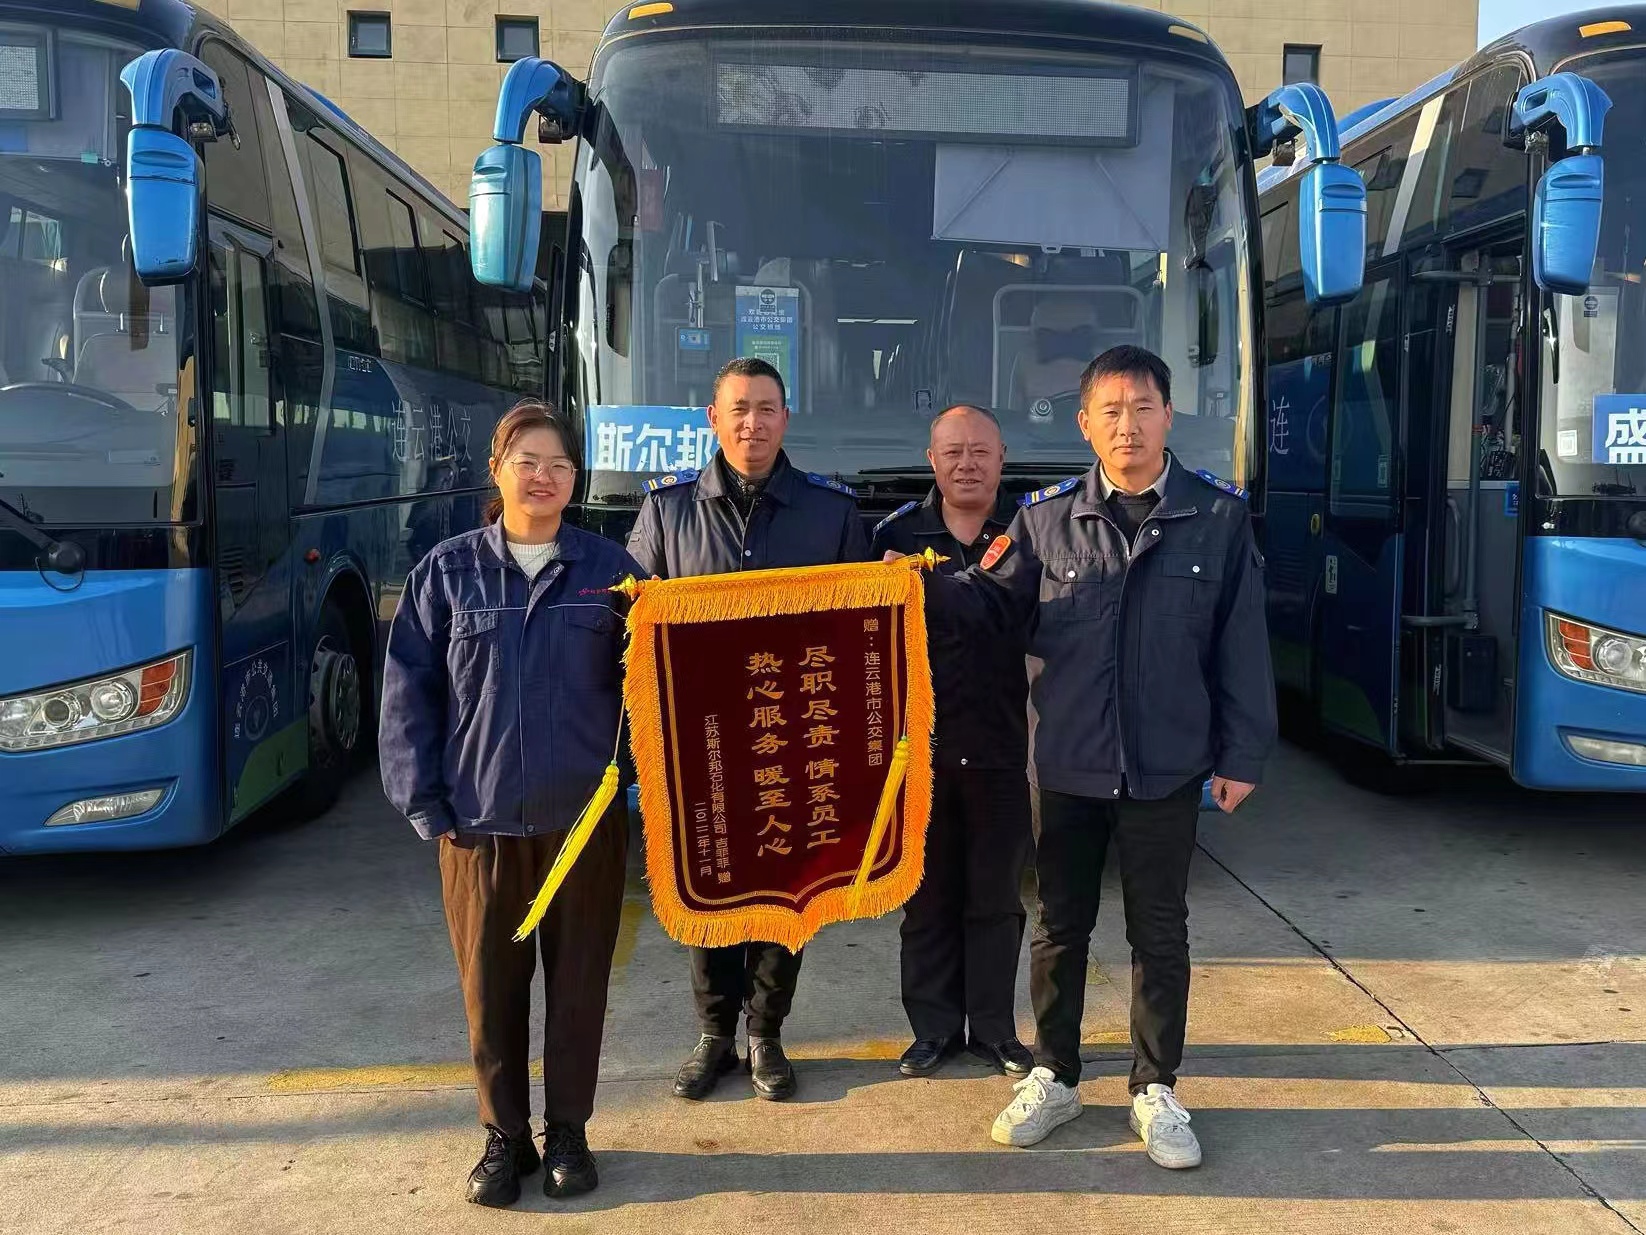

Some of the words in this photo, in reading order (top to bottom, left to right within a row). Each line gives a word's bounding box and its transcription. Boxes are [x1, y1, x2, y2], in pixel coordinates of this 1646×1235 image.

[595, 422, 714, 472] 斯尔邦
[1269, 396, 1290, 455] 连
[703, 713, 728, 836] 江苏斯尔邦石化有限公司
